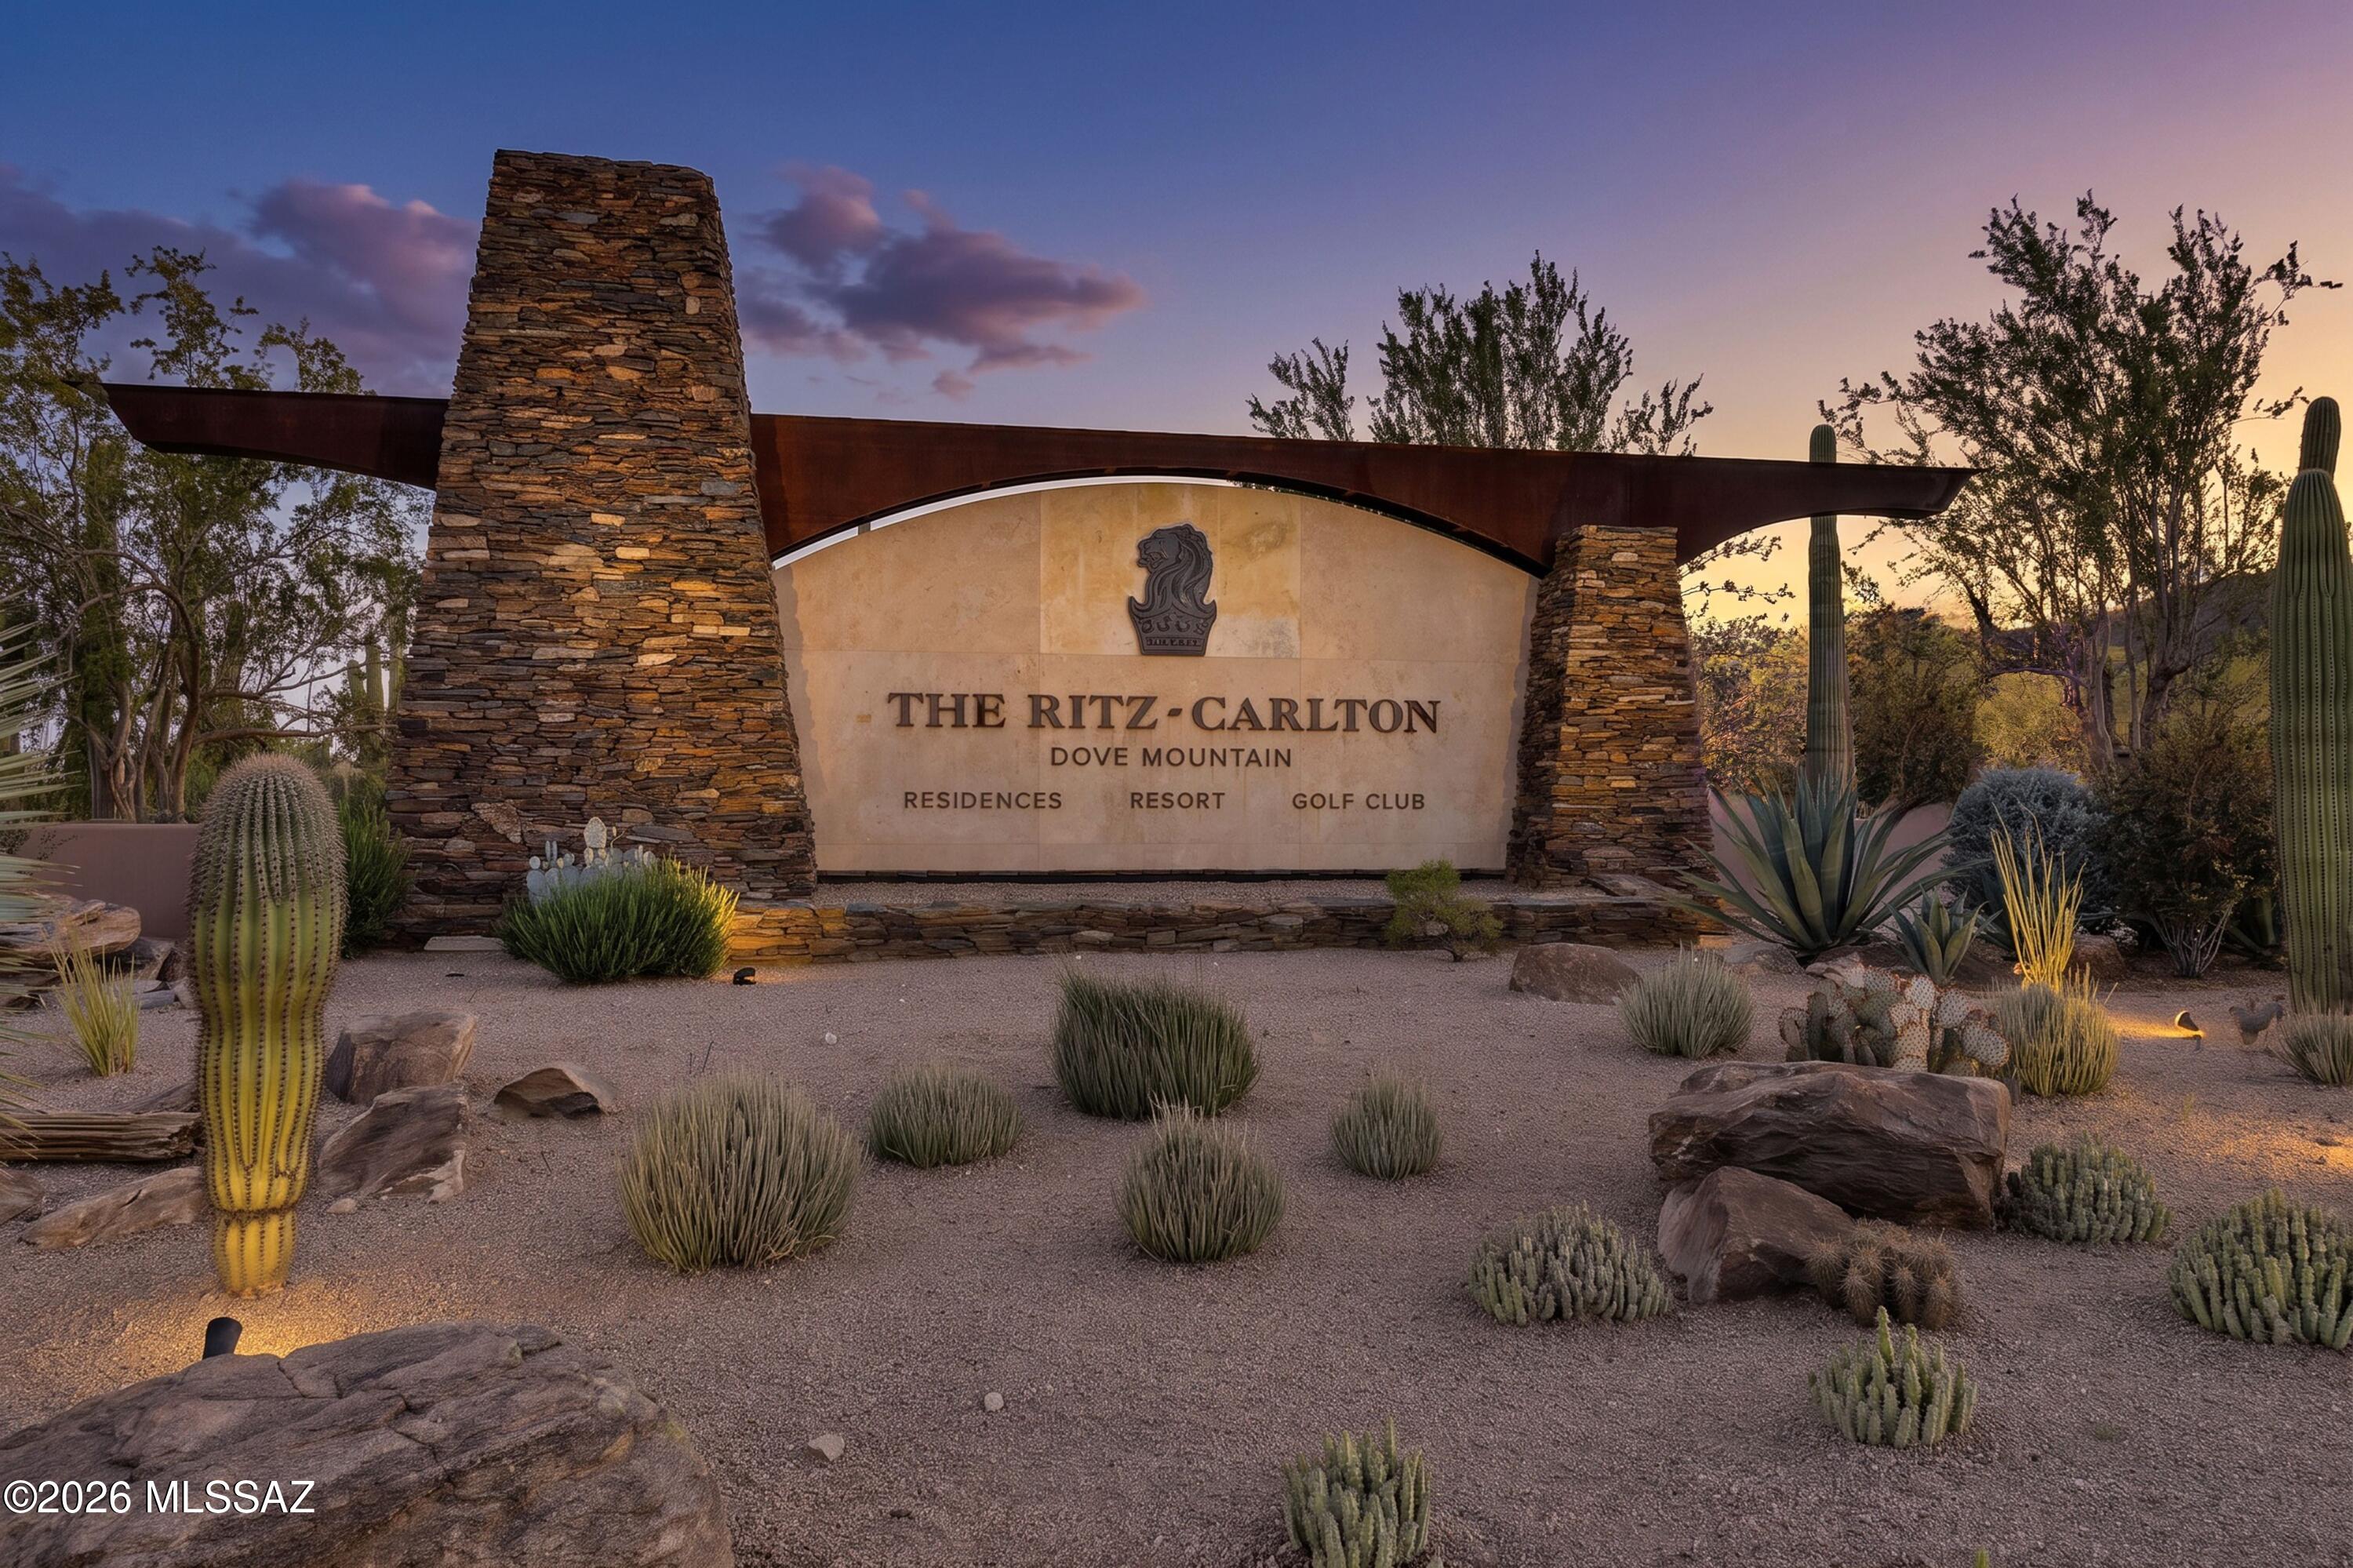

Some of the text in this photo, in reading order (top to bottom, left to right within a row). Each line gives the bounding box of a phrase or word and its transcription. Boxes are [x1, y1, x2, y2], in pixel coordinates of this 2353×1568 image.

[887, 692, 1442, 735] THE RITZ-CARLTON
[1050, 746, 1292, 769] DOVE MOUNTAIN
[903, 791, 1063, 811] RESIDENCES
[1129, 791, 1226, 811] RESORT
[1292, 792, 1426, 811] GOLF CLUB
